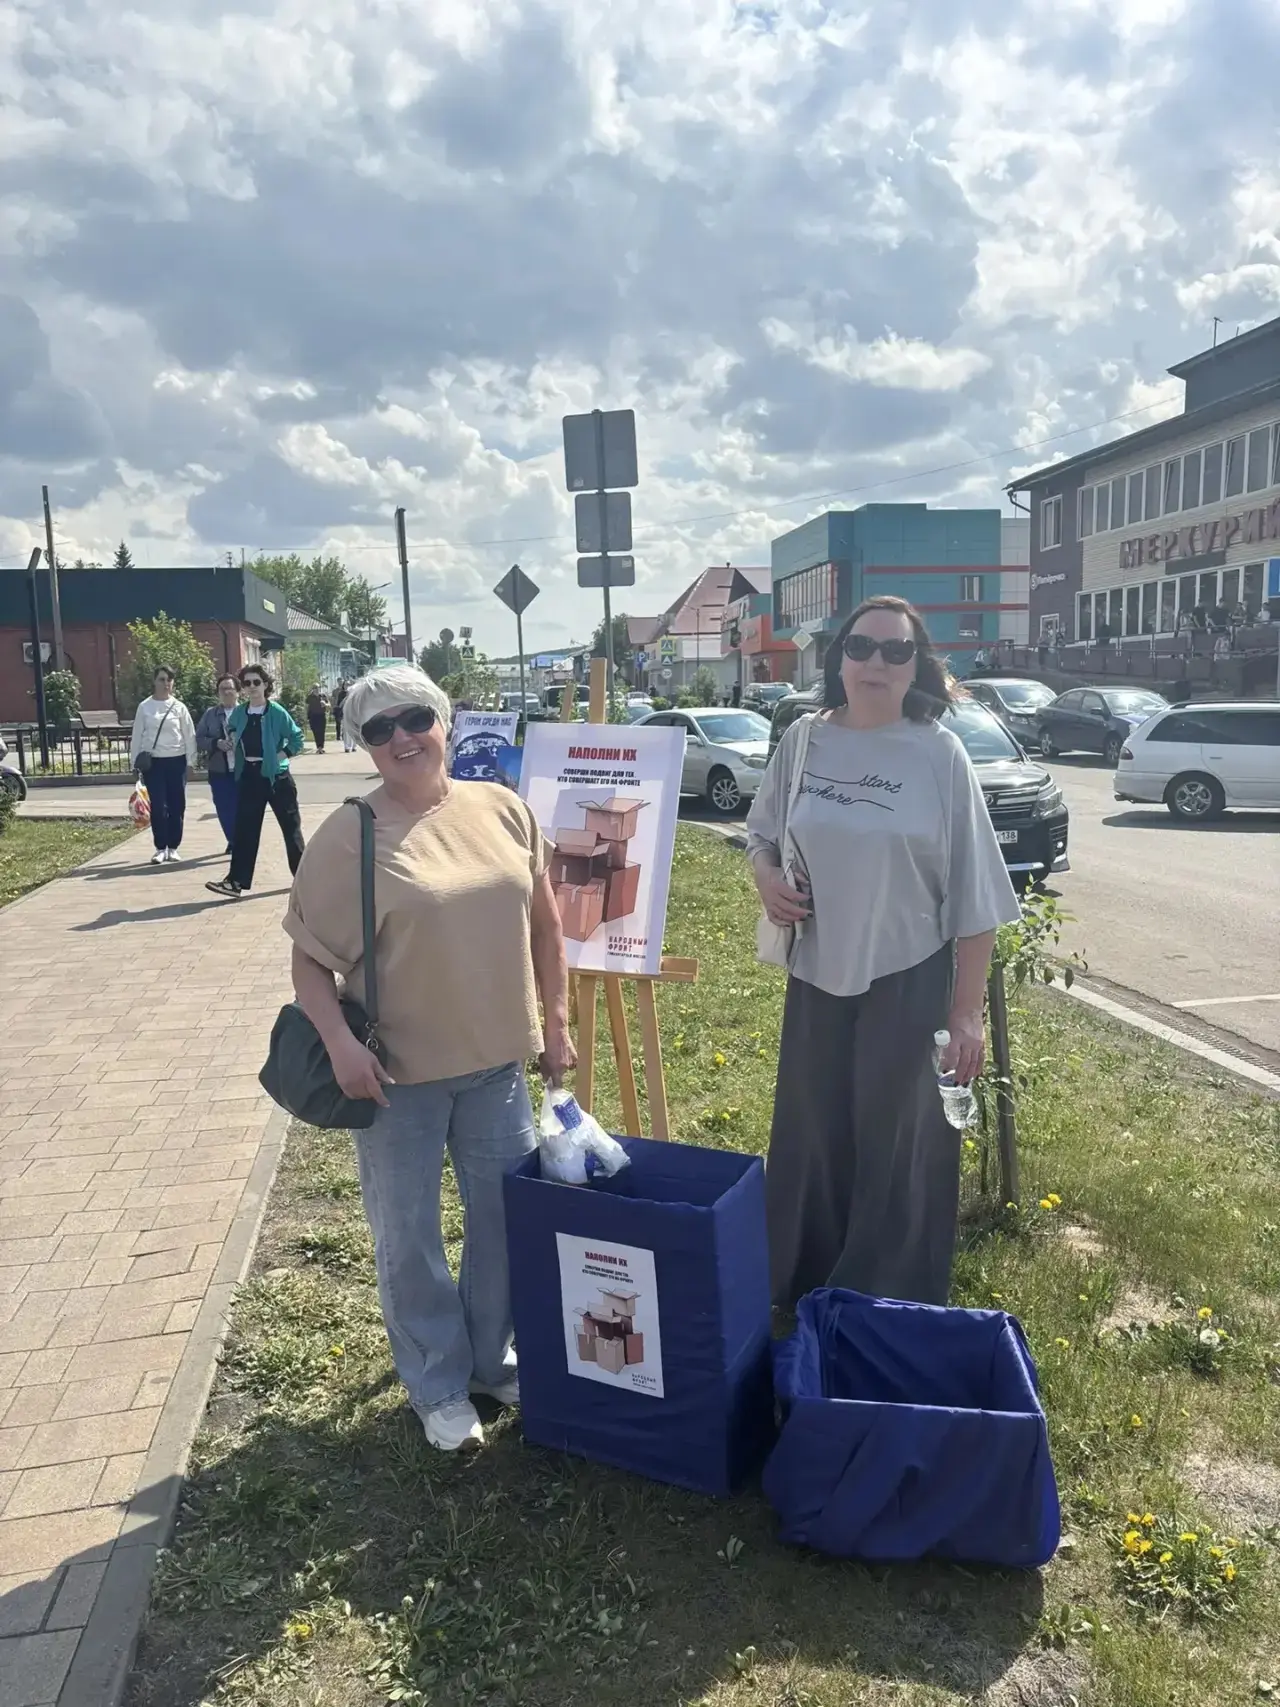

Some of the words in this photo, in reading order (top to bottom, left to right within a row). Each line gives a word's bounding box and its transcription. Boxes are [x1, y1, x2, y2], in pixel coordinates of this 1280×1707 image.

[482, 716, 499, 727] СРЕДИ
[500, 717, 513, 726] НАС
[568, 746, 621, 761] НАПОЛНИ
[622, 748, 637, 761] ИХ
[563, 768, 589, 776] СОВЕРШИ
[590, 769, 612, 777] ПОДВИГ
[612, 770, 624, 778] ДЛЯ
[568, 776, 600, 785] СОВЕРШАЕТ
[1001, 831, 1016, 839] 138
[608, 936, 648, 946] НАРОДНЫЙ
[608, 943, 632, 952] ФРОНТ
[584, 1251, 618, 1265] НАПОЛНИ
[618, 1257, 628, 1267] ИХ
